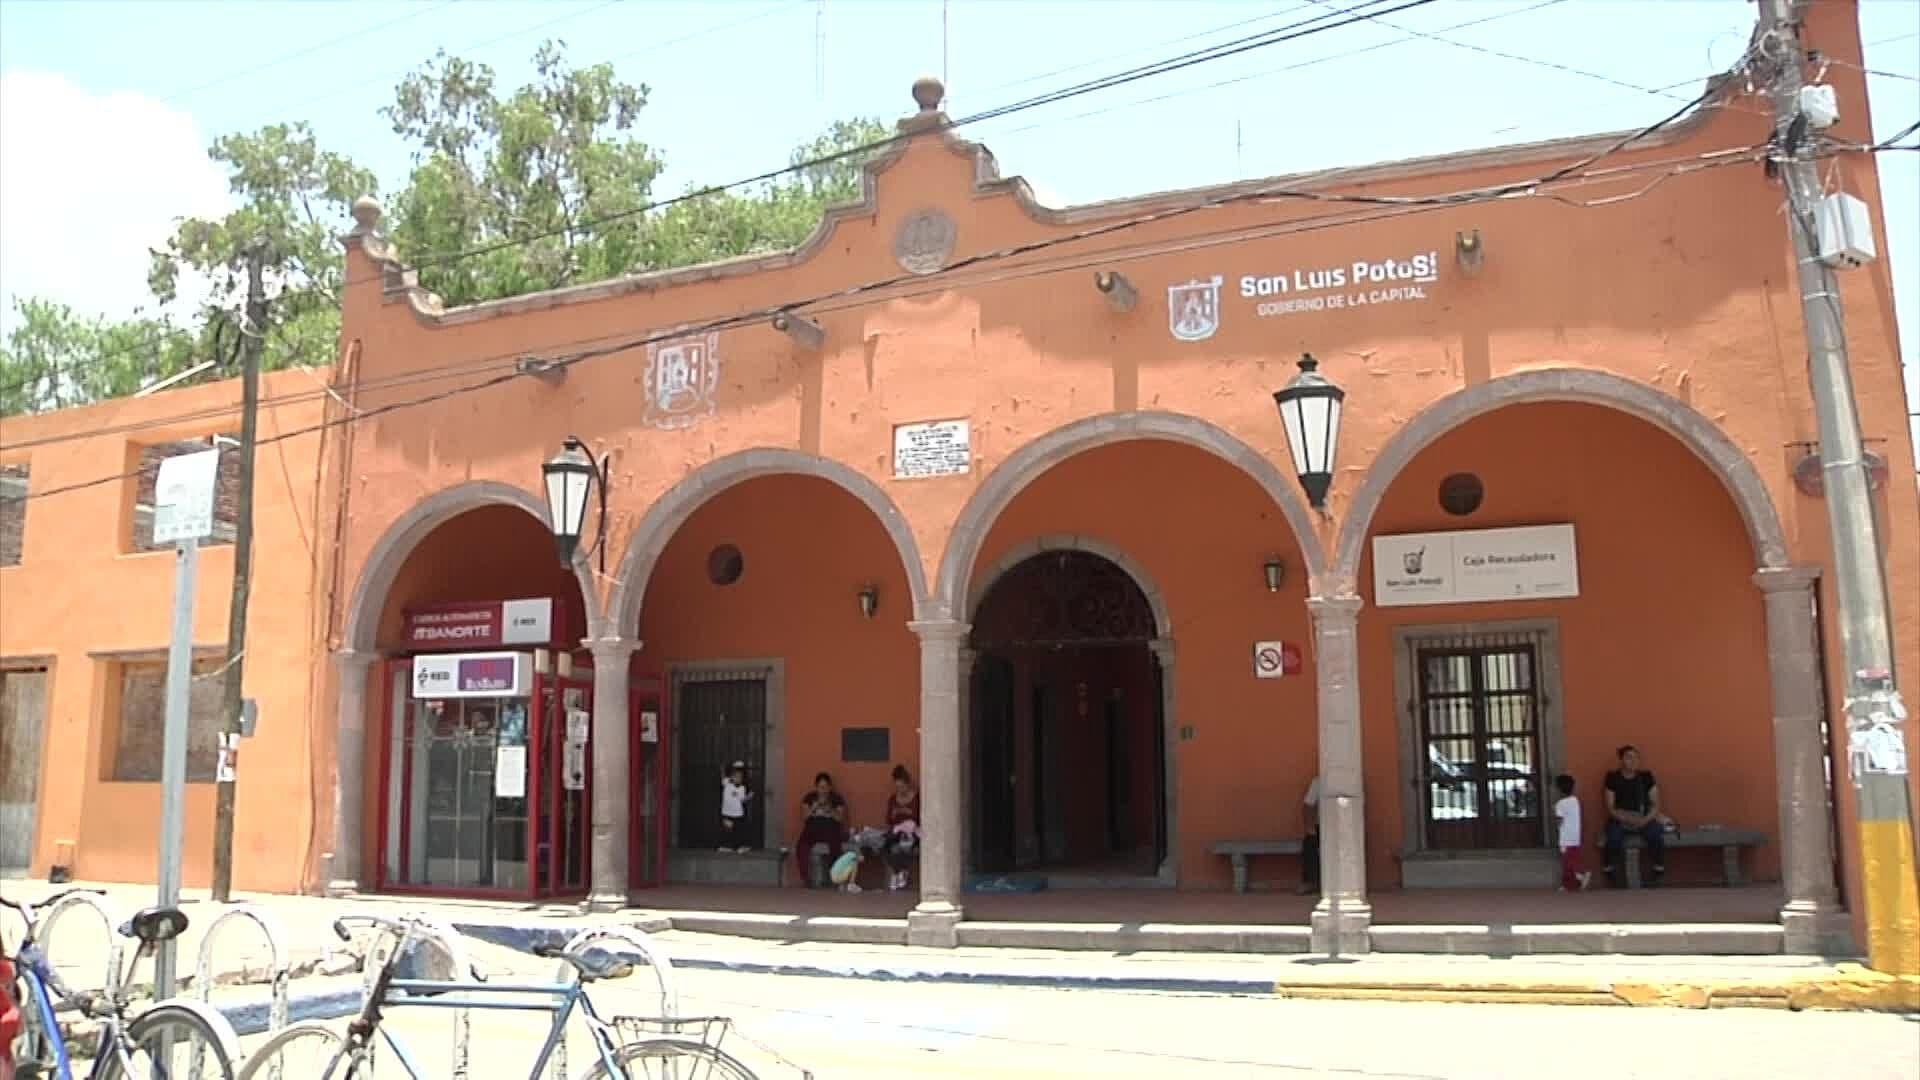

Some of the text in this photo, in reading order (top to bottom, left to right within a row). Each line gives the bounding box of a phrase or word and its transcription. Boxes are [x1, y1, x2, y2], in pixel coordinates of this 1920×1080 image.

[1240, 275, 1289, 297] San
[1295, 268, 1346, 291] Luis
[1257, 287, 1427, 316] GOBIERNO DE LA CAPITAL
[1463, 555, 1485, 567] Caja
